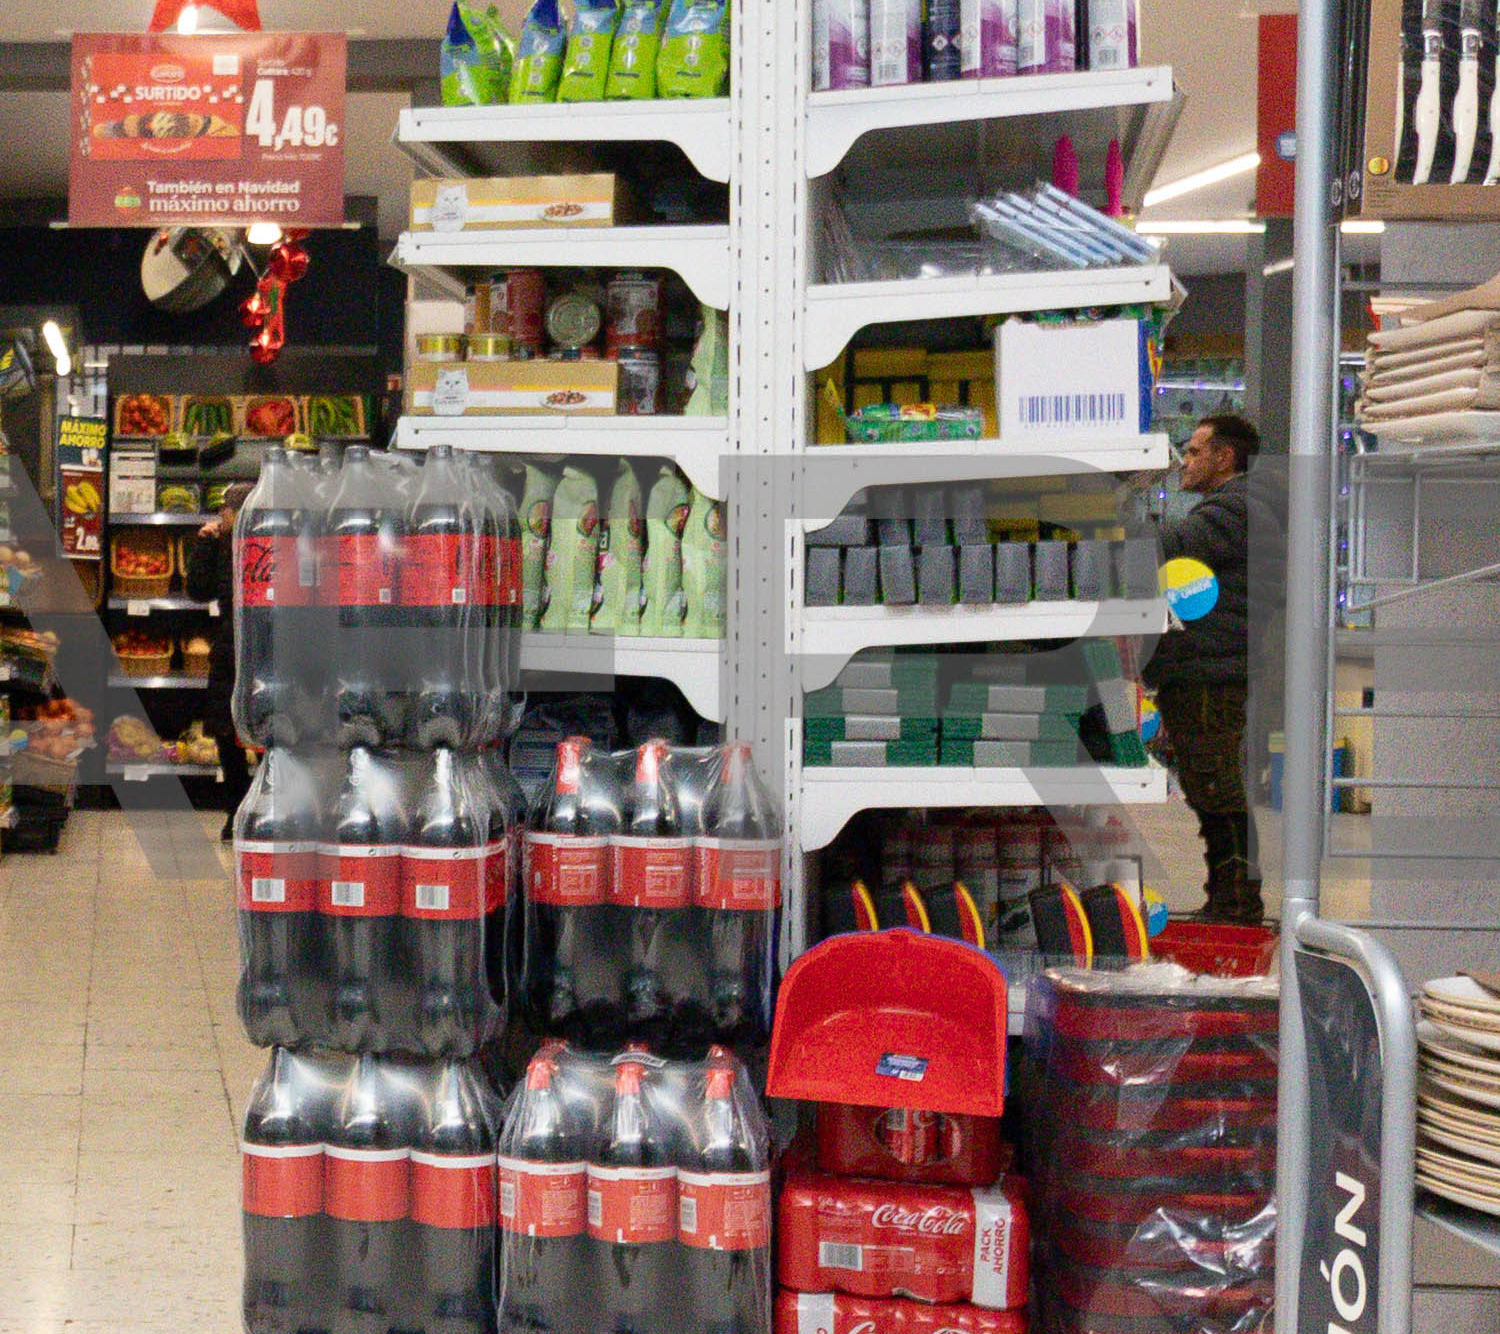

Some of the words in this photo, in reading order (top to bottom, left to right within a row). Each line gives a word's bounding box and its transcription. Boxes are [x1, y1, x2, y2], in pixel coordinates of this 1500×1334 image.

[246, 79, 338, 151] 4,49€
[147, 181, 212, 195] También
[215, 184, 234, 194] en
[238, 181, 300, 195] Navidad
[149, 197, 229, 213] máximo
[233, 197, 300, 213] ahorro
[979, 1228, 991, 1264] PACK
